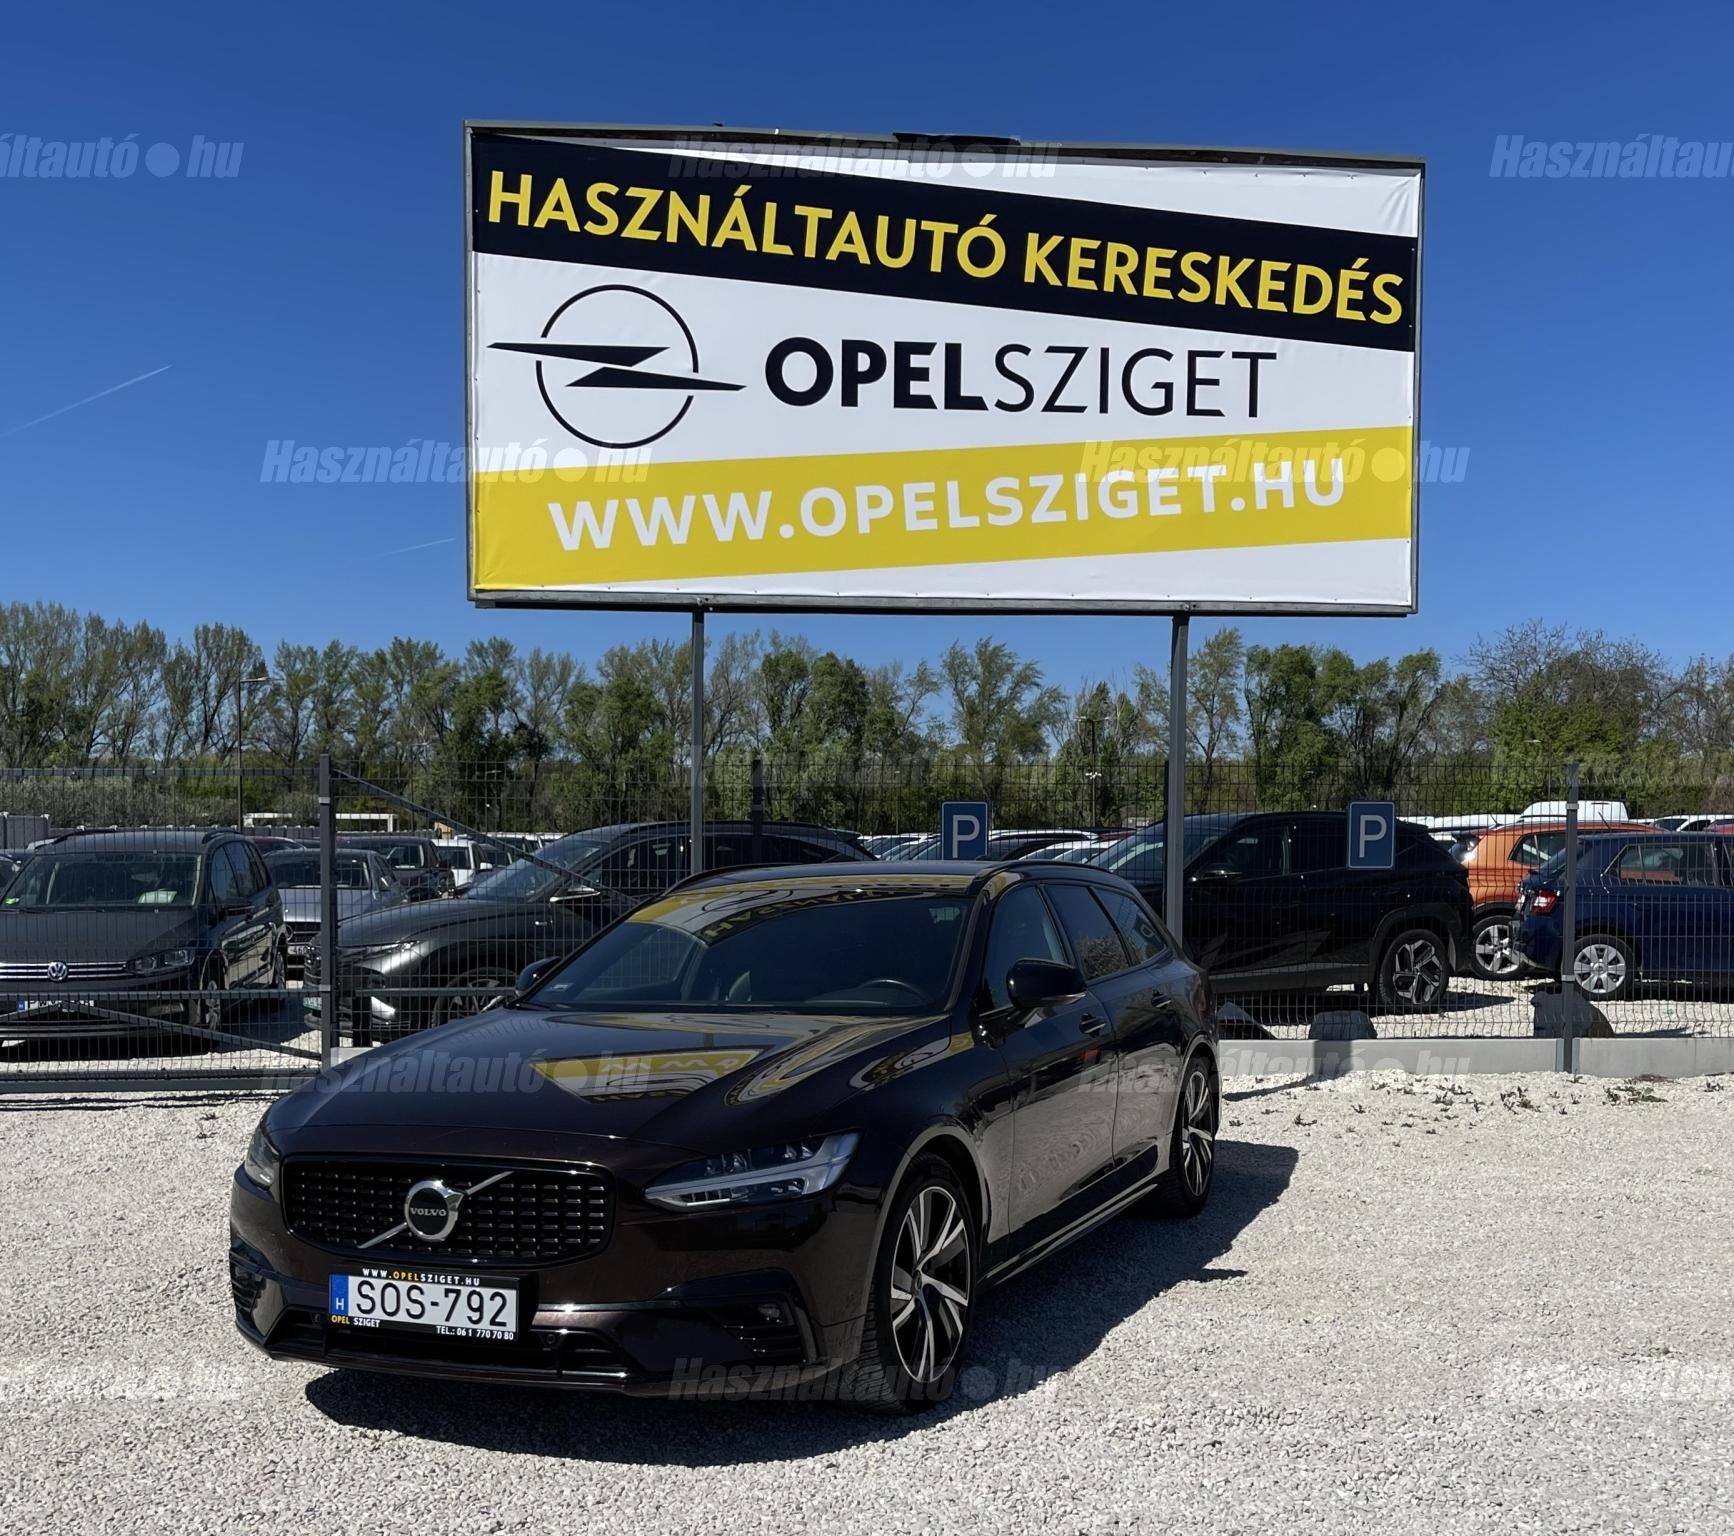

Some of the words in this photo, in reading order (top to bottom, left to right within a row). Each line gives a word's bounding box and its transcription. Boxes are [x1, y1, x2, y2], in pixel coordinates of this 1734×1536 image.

[488, 171, 1006, 278] HASZNÁLTAUTÓ
[1023, 232, 1404, 325] KERESKEDÉS
[765, 336, 1278, 418] OPELSZIGET
[548, 458, 1345, 552] WWW.OPELSZIGET.HU
[952, 814, 980, 858] P
[1359, 814, 1387, 858] P
[410, 1207, 447, 1217] VOLVO
[362, 1268, 480, 1287] WWW.OPELSZIGET.HU
[331, 1315, 351, 1325] OPEL
[353, 1317, 381, 1328] SZIGET
[335, 1298, 345, 1311] H
[356, 1279, 508, 1328] SOS-792
[476, 1329, 491, 1339] 770
[492, 1331, 503, 1340] 70
